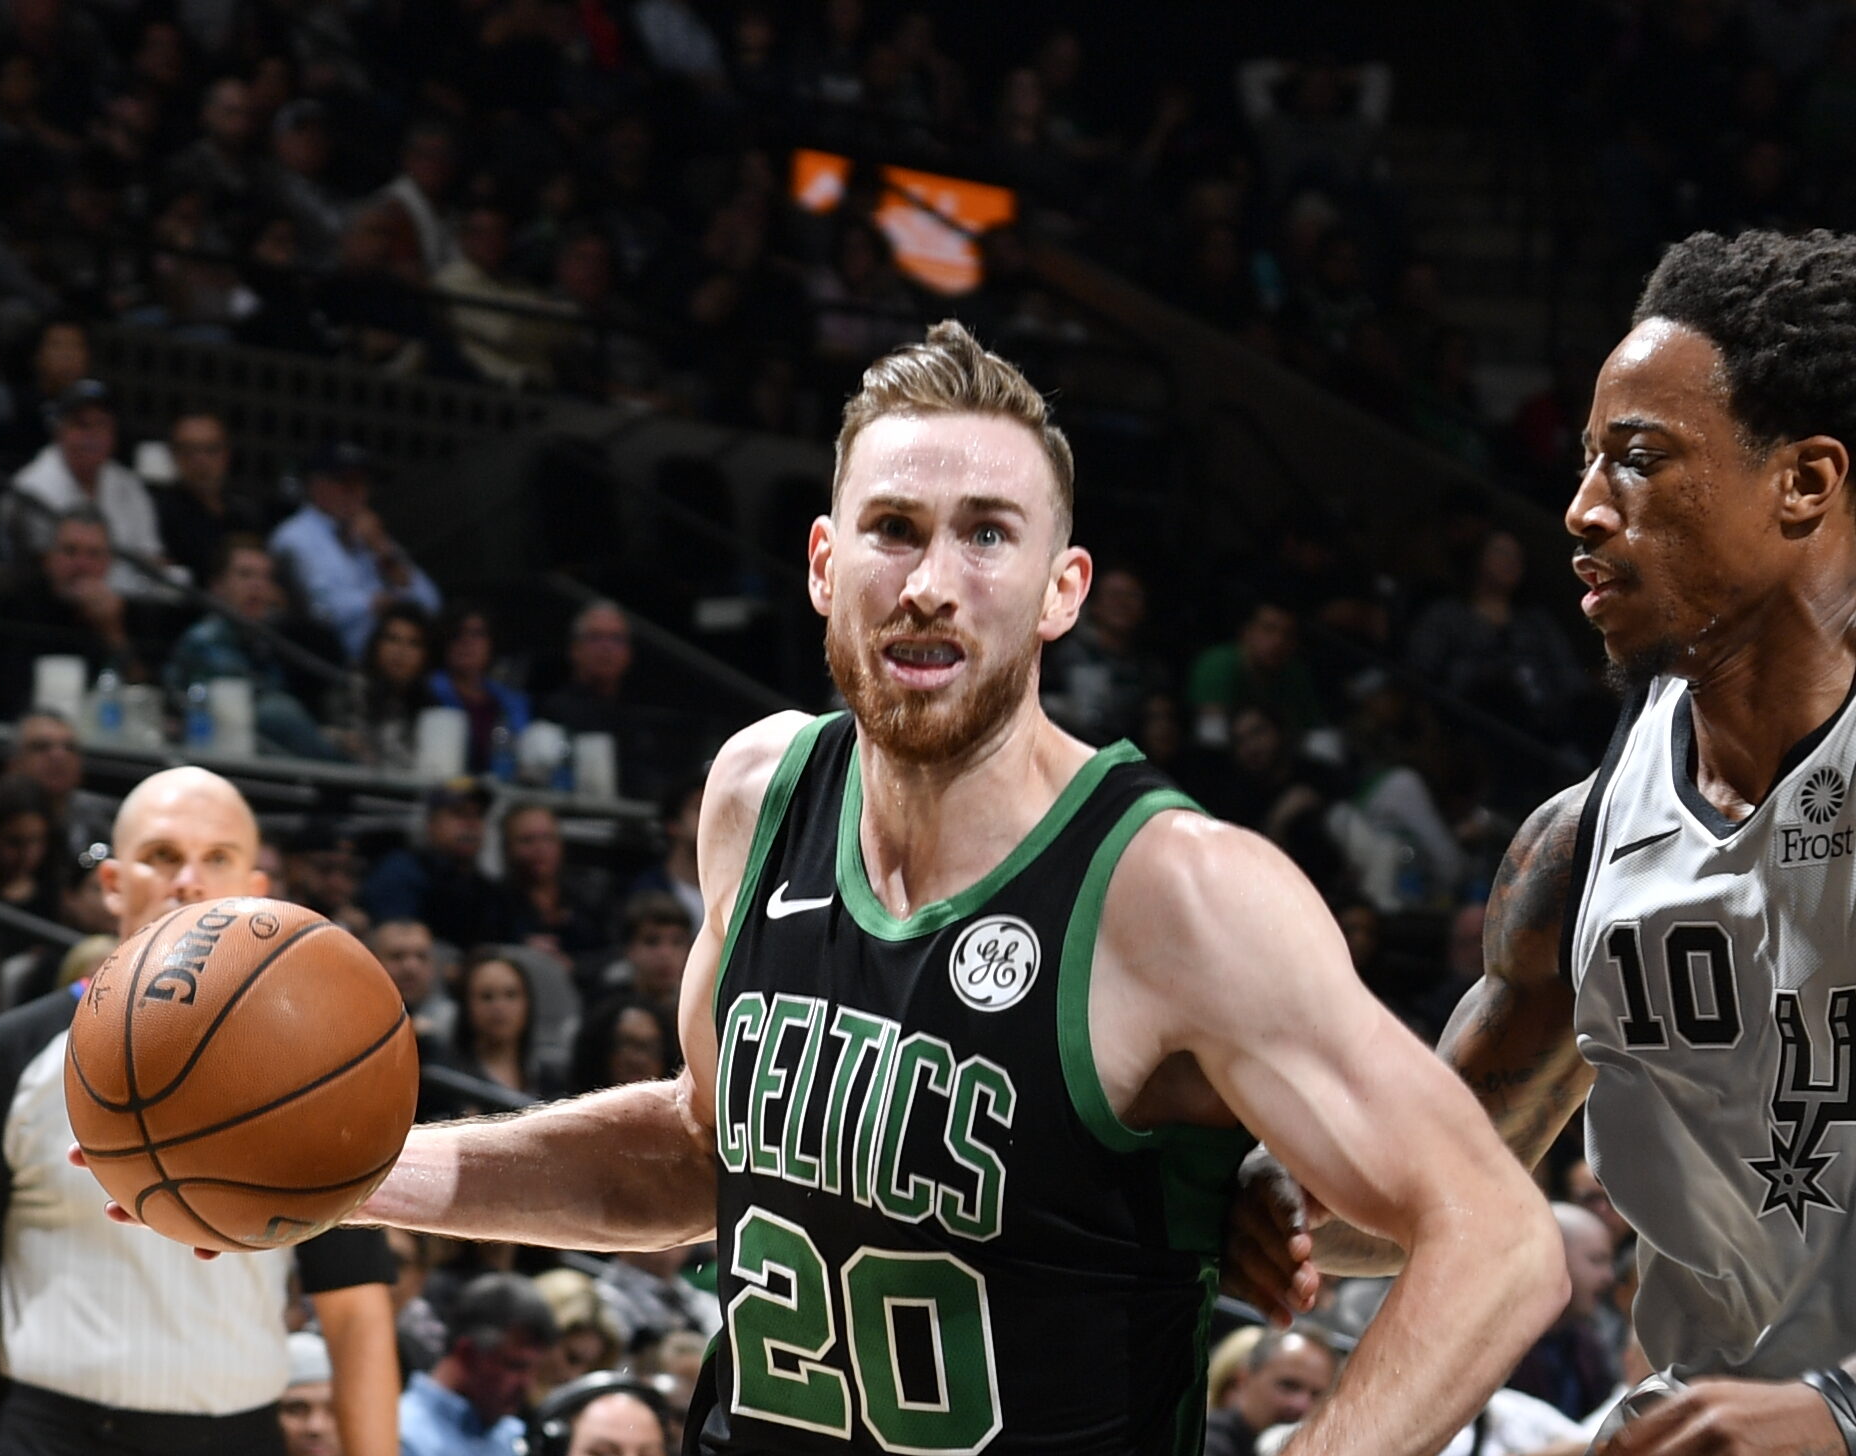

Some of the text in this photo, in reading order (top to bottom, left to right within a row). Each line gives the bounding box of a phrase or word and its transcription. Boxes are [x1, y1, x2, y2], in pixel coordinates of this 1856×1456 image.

[1781, 824, 1854, 863] Frost
[1603, 920, 1744, 1050] 10
[716, 991, 1017, 1241] CELTICS
[728, 1205, 1004, 1456] 20
